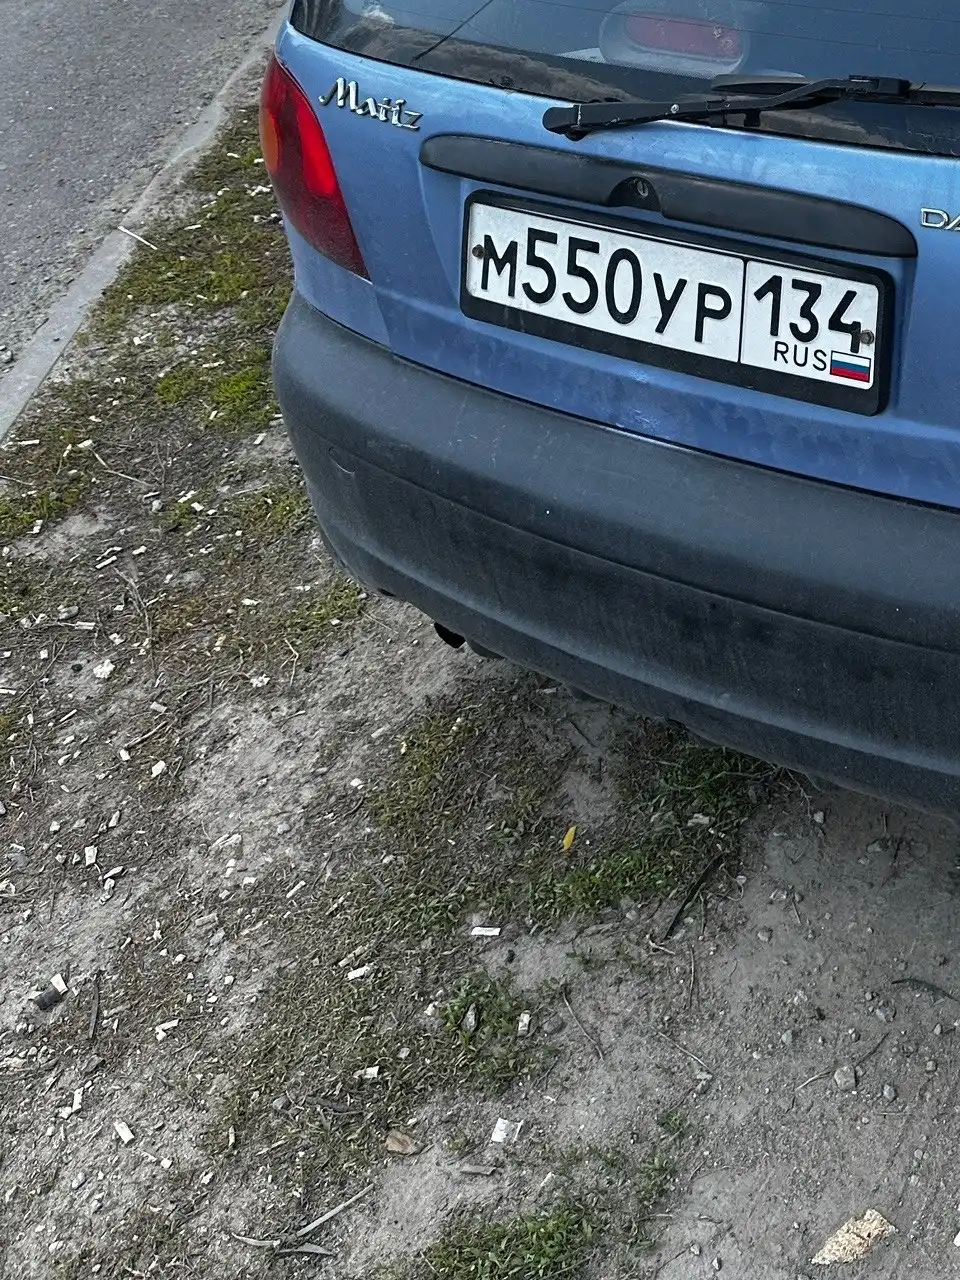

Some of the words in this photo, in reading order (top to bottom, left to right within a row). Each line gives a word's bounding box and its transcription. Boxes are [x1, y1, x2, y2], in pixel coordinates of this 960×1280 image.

[318, 77, 423, 130] Matiz
[753, 275, 861, 354] 134
[773, 340, 827, 372] RUS
